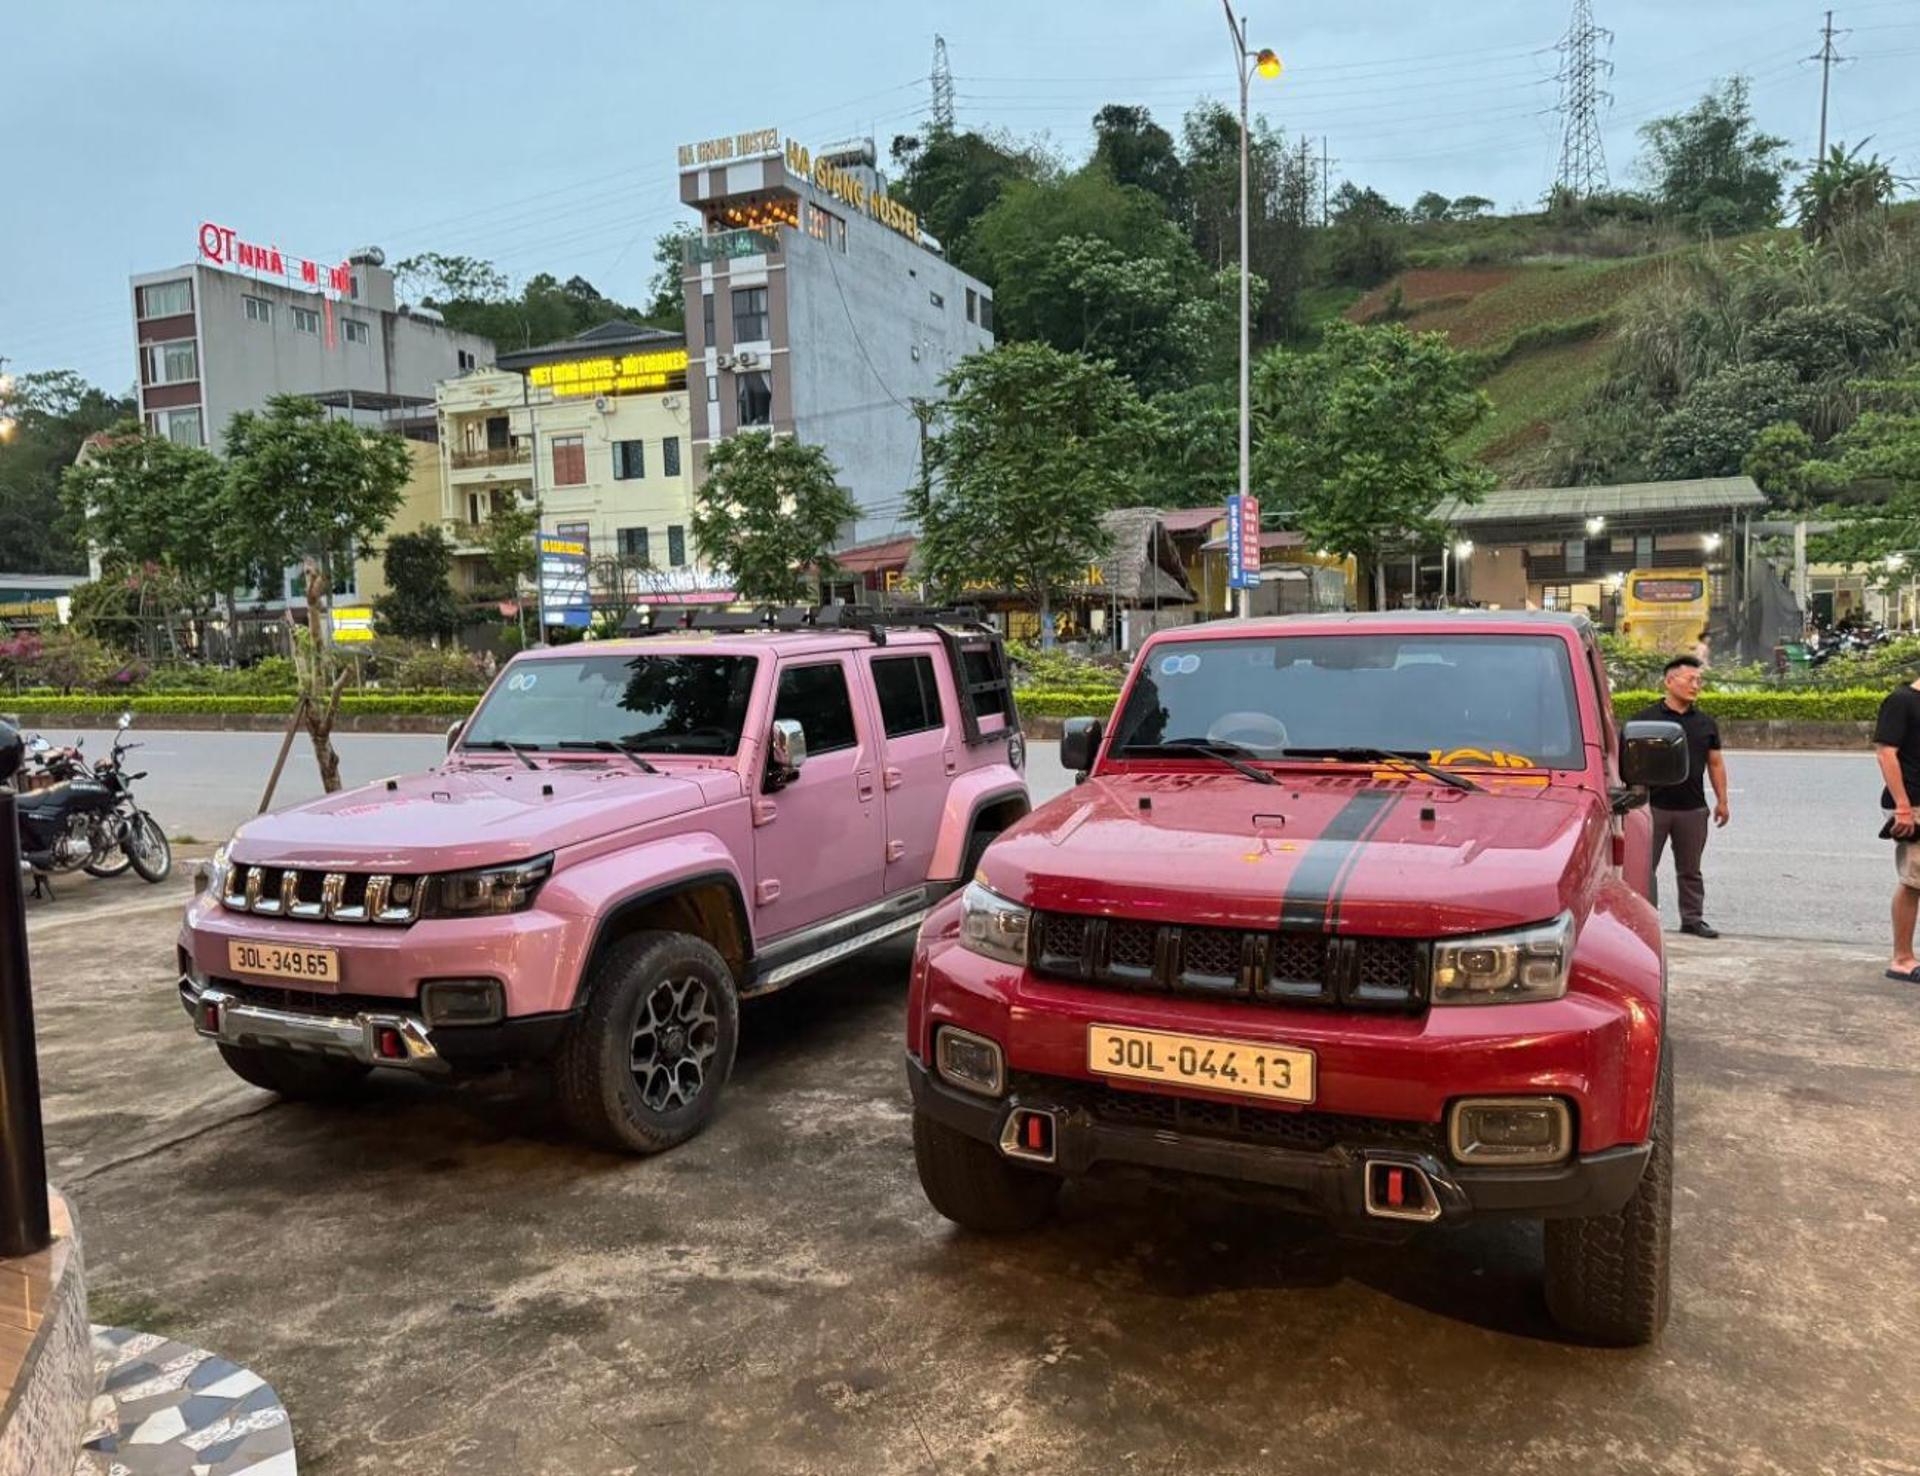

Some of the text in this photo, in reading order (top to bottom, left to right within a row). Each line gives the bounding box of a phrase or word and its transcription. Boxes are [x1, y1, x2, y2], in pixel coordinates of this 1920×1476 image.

[736, 128, 779, 157] HOSTEL
[785, 137, 920, 241] HA GIANG HOSTEL
[200, 223, 236, 264] QT
[238, 243, 284, 274] NHÀ
[237, 947, 328, 976] 30L-349.65
[1107, 1036, 1292, 1090] 30L-044.13
